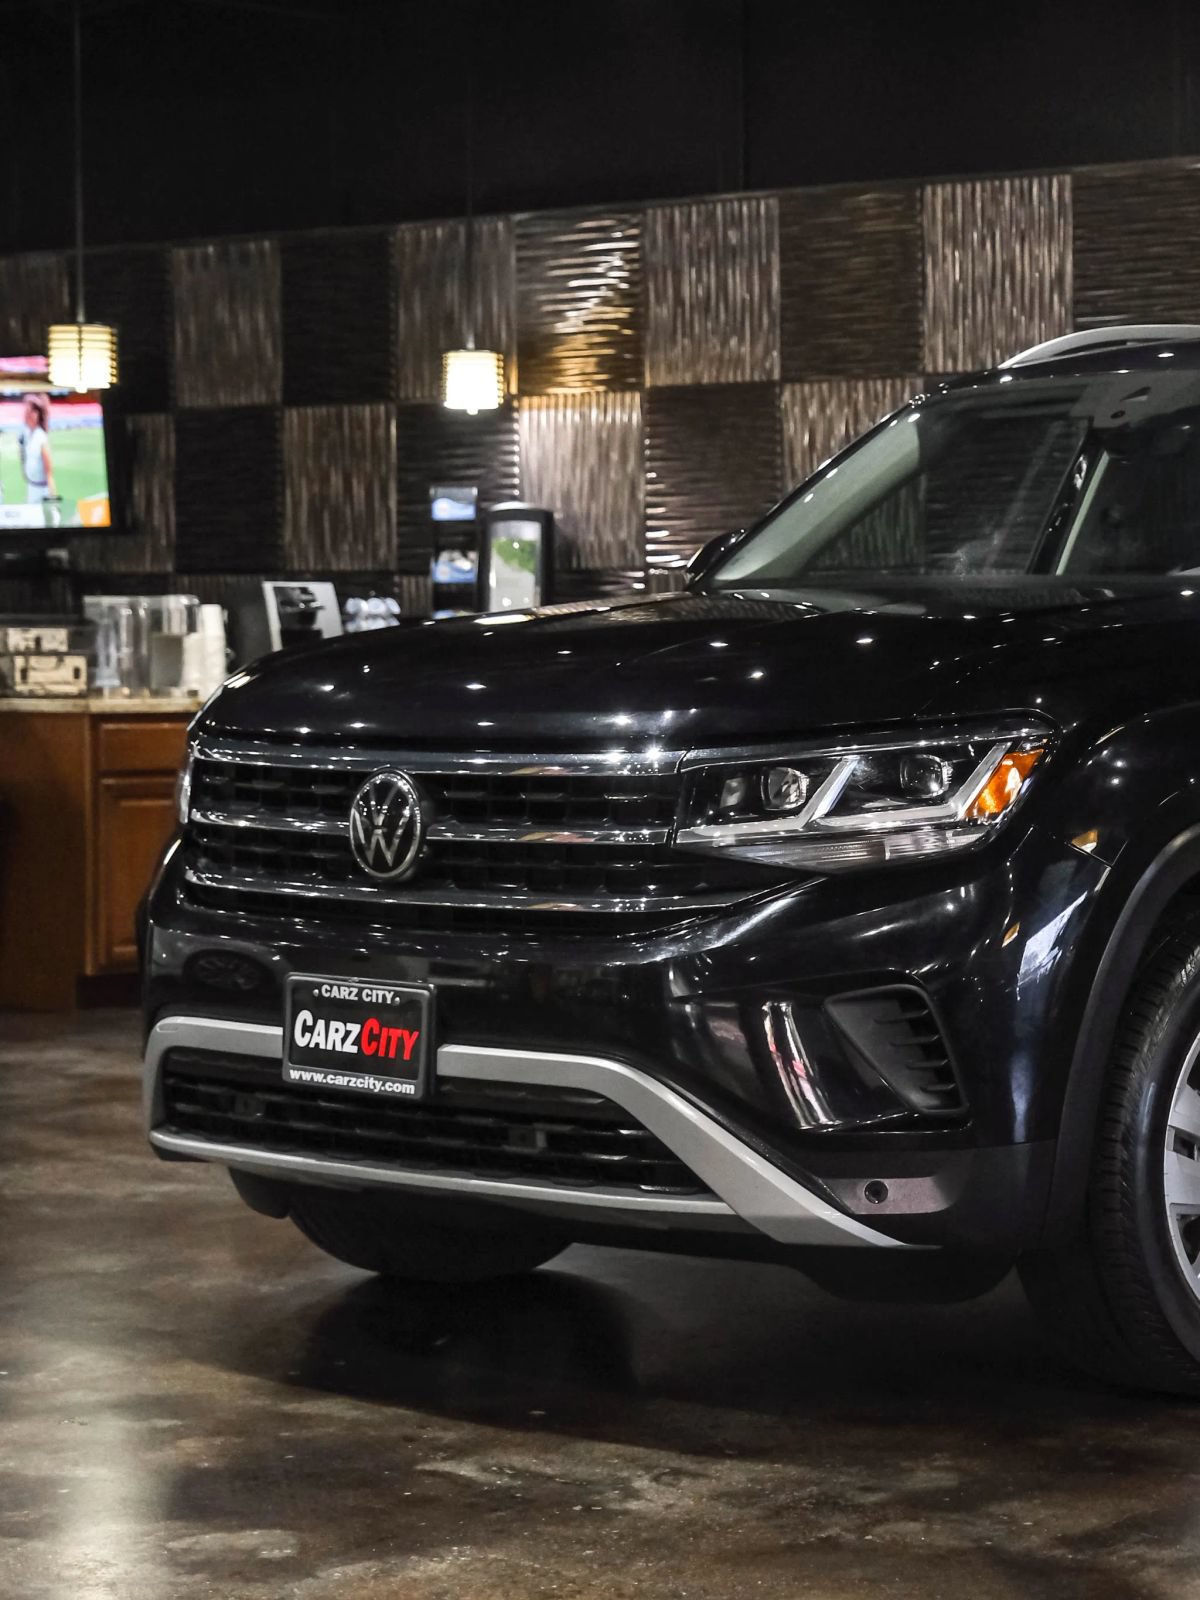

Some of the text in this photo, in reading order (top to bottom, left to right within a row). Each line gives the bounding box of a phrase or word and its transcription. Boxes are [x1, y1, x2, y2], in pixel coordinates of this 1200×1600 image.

[350, 769, 421, 877] VW
[321, 984, 395, 1004] CARZ CITY
[289, 1069, 415, 1095] www.carzcity.com
